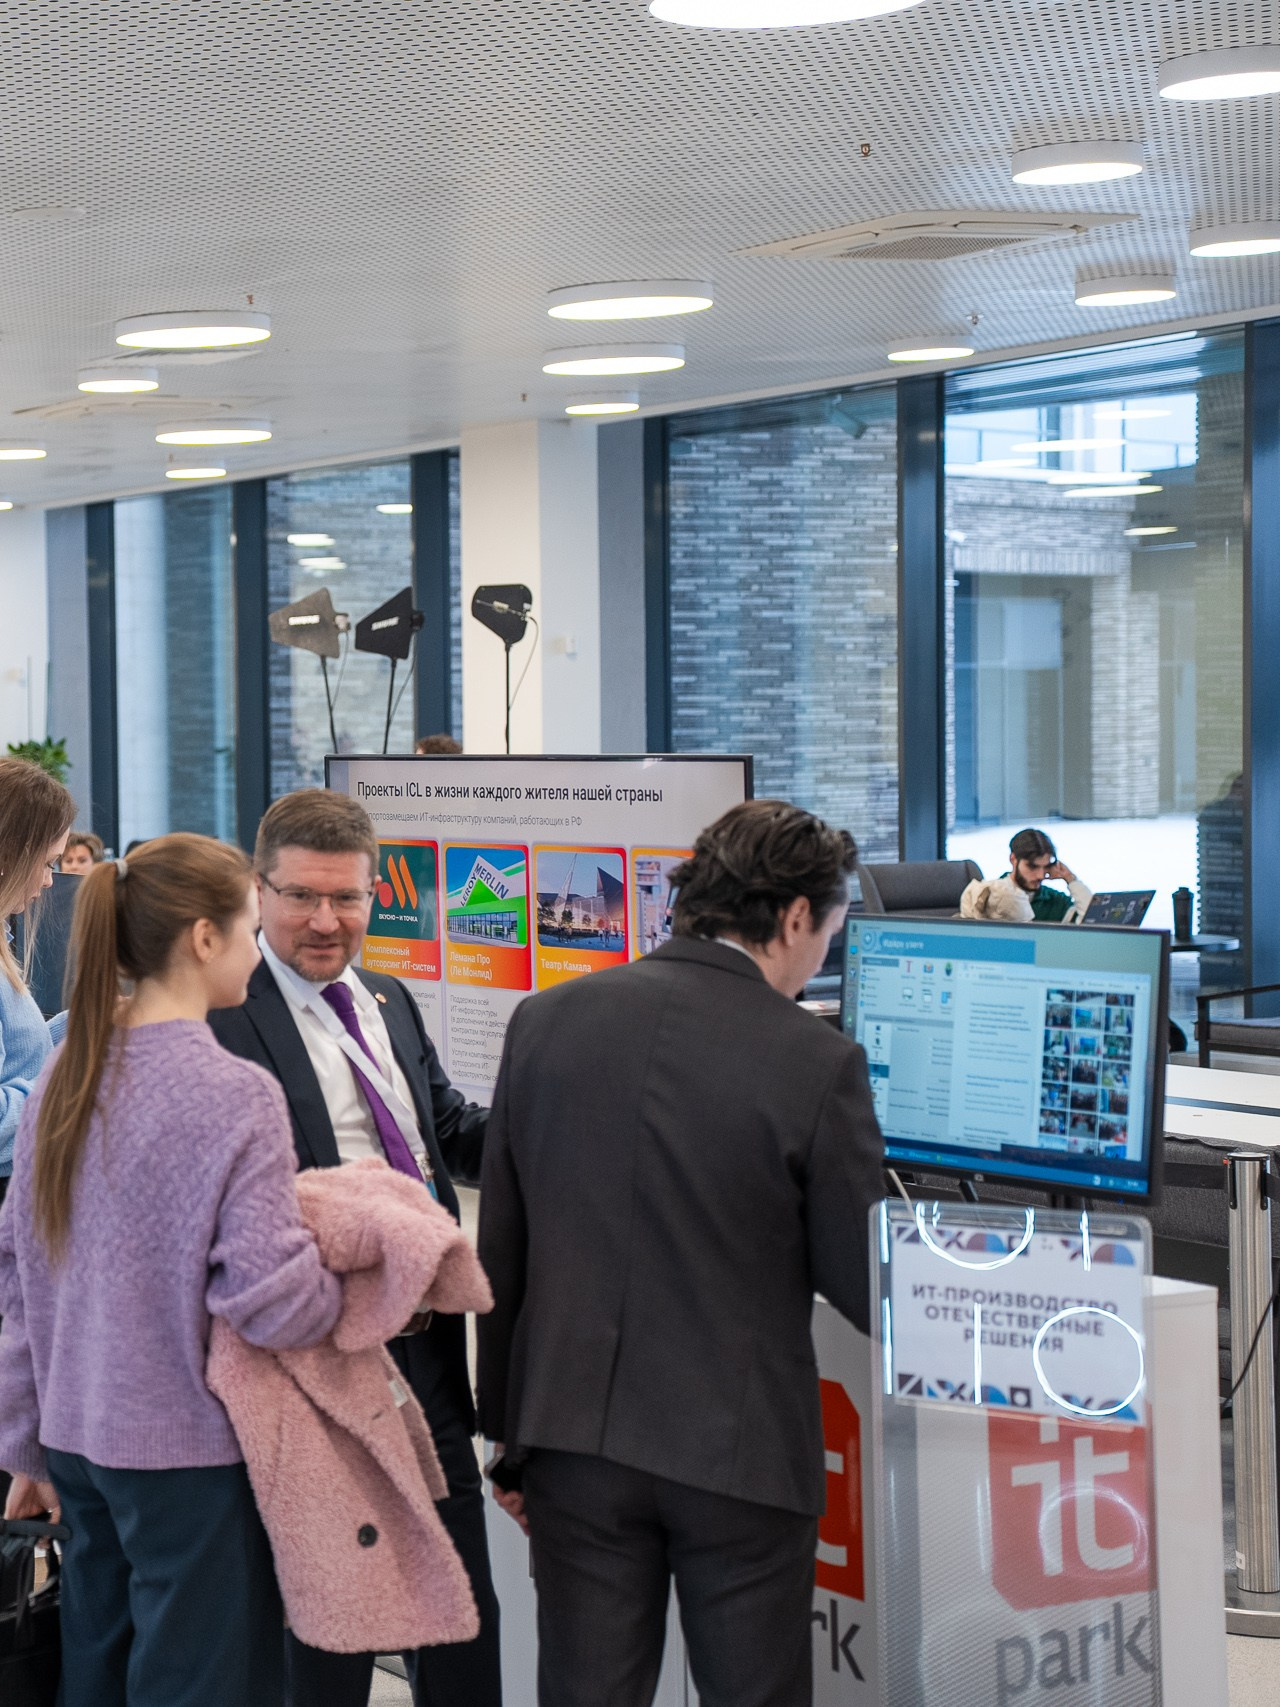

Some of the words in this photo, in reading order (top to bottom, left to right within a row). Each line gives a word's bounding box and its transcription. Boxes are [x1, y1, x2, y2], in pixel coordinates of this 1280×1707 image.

[357, 781, 403, 799] Проекты
[406, 783, 422, 798] ICL
[425, 788, 431, 798] в
[434, 788, 470, 798] жизни
[473, 788, 521, 802] каждого
[524, 788, 569, 801] жителя
[572, 786, 612, 801] нашей
[615, 788, 663, 805] страны
[368, 812, 418, 823] портозамещаем
[419, 813, 483, 826] ИТ-инфраструктуру
[483, 814, 518, 826] компаний,
[520, 816, 564, 827] работающих
[571, 816, 583, 827] РФ
[460, 873, 478, 907] LEROY
[474, 863, 509, 900] MERLIN
[366, 943, 410, 956] Комплексный
[449, 951, 475, 964] Лемана
[476, 953, 491, 965] Про
[366, 959, 401, 971] аутсорсинг
[401, 959, 436, 973] ИТ-систем
[449, 964, 466, 978] (Ле
[466, 965, 493, 981] Монлид)
[540, 958, 562, 972] Театр
[563, 960, 592, 973] Камала
[450, 994, 477, 1005] Поддержка
[911, 1283, 1118, 1316] ИТ-ПРОИЗВОДСТВО
[1011, 1417, 1134, 1577] it
[995, 1601, 1158, 1702] park
